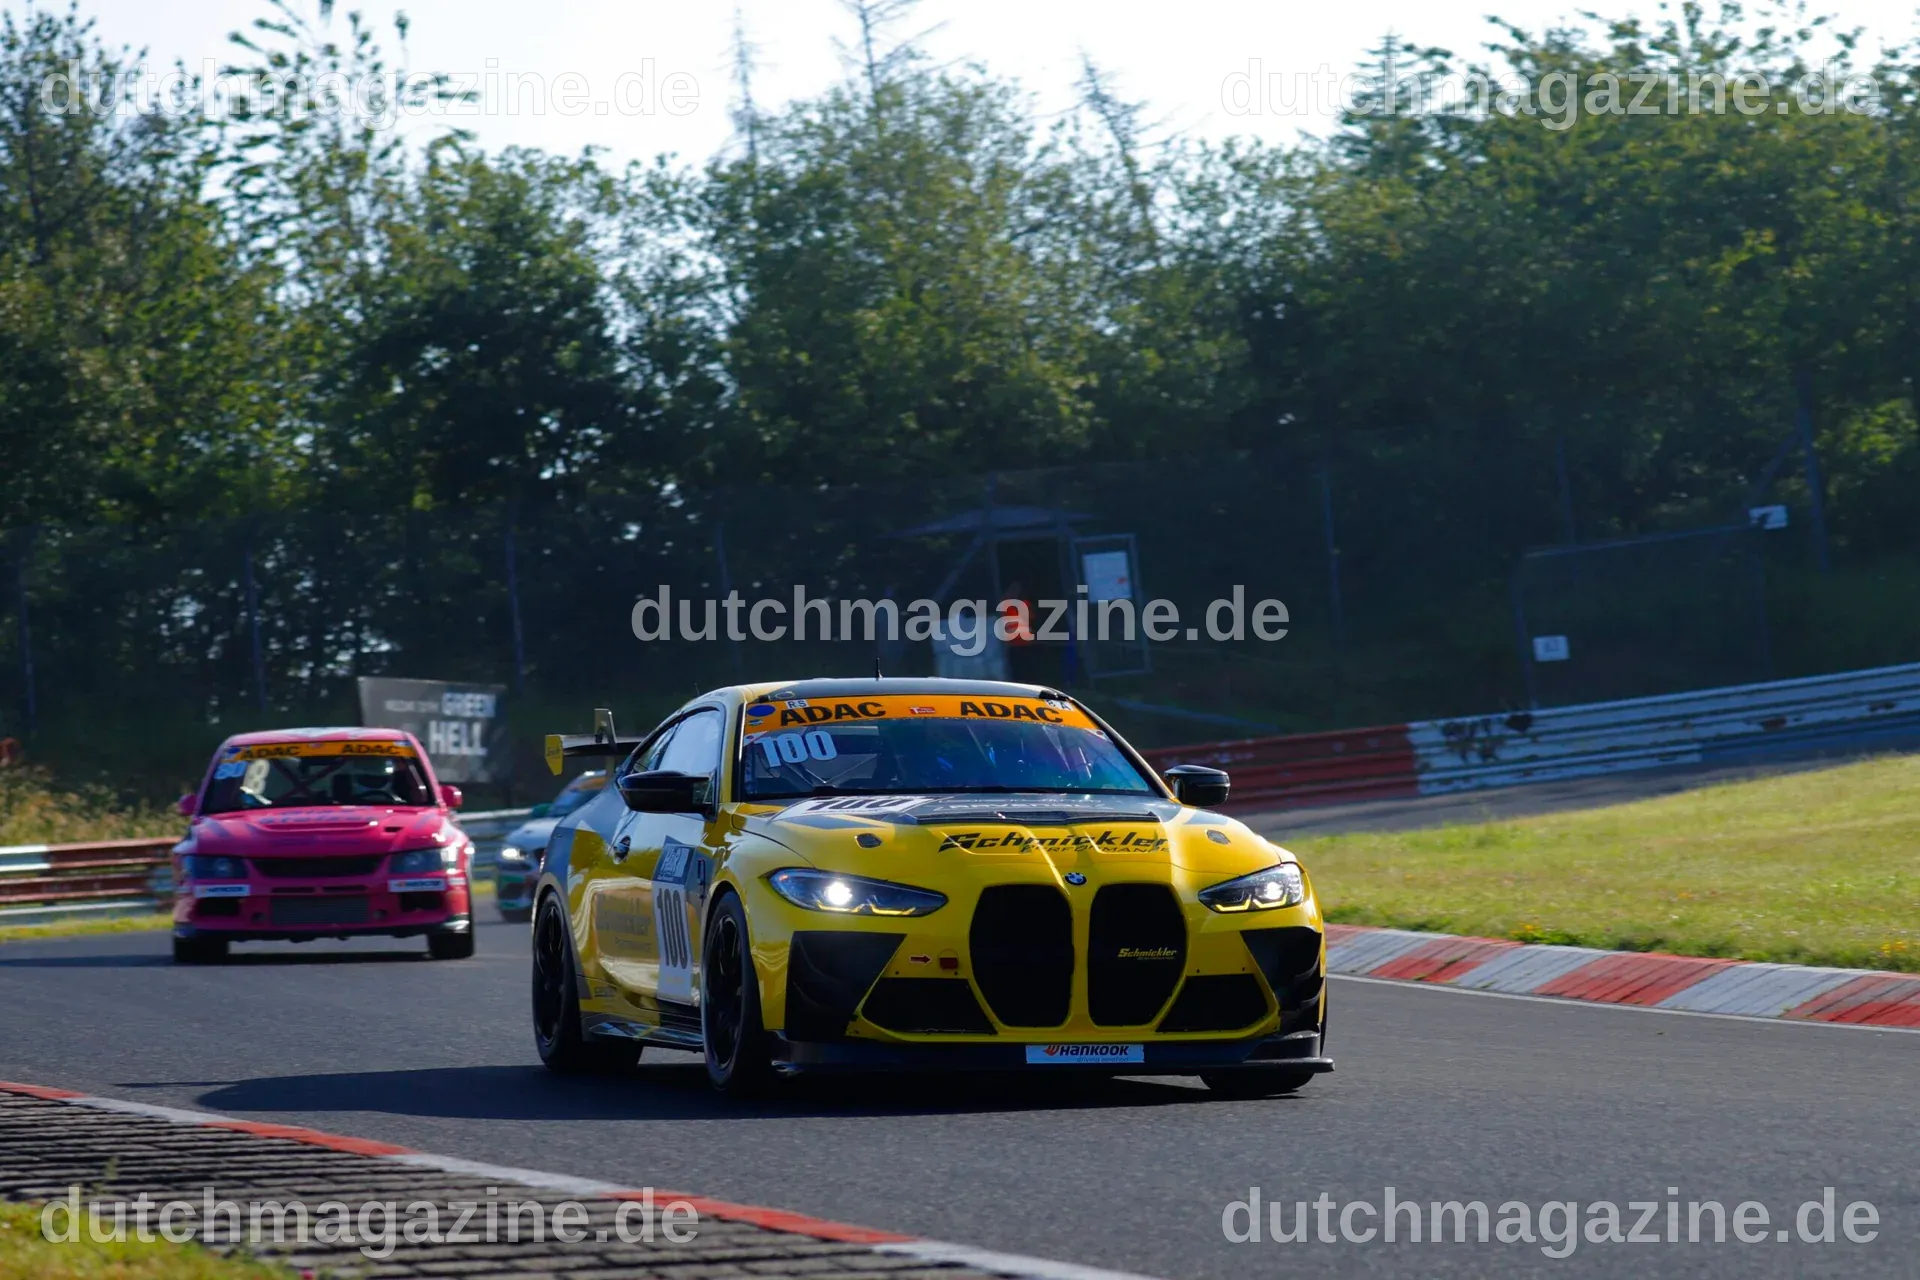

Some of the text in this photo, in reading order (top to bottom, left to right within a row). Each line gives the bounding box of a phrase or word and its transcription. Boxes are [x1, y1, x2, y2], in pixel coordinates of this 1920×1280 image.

[780, 702, 886, 726] ADAC
[960, 701, 1064, 723] ADAC
[429, 720, 488, 756] HELL
[243, 745, 301, 759] ADAC
[342, 743, 398, 755] ADAC
[754, 731, 838, 768] 100
[806, 799, 916, 811] 100
[938, 831, 1170, 852] Schmickler
[657, 888, 688, 969] 100
[1117, 947, 1177, 958] Schmickler
